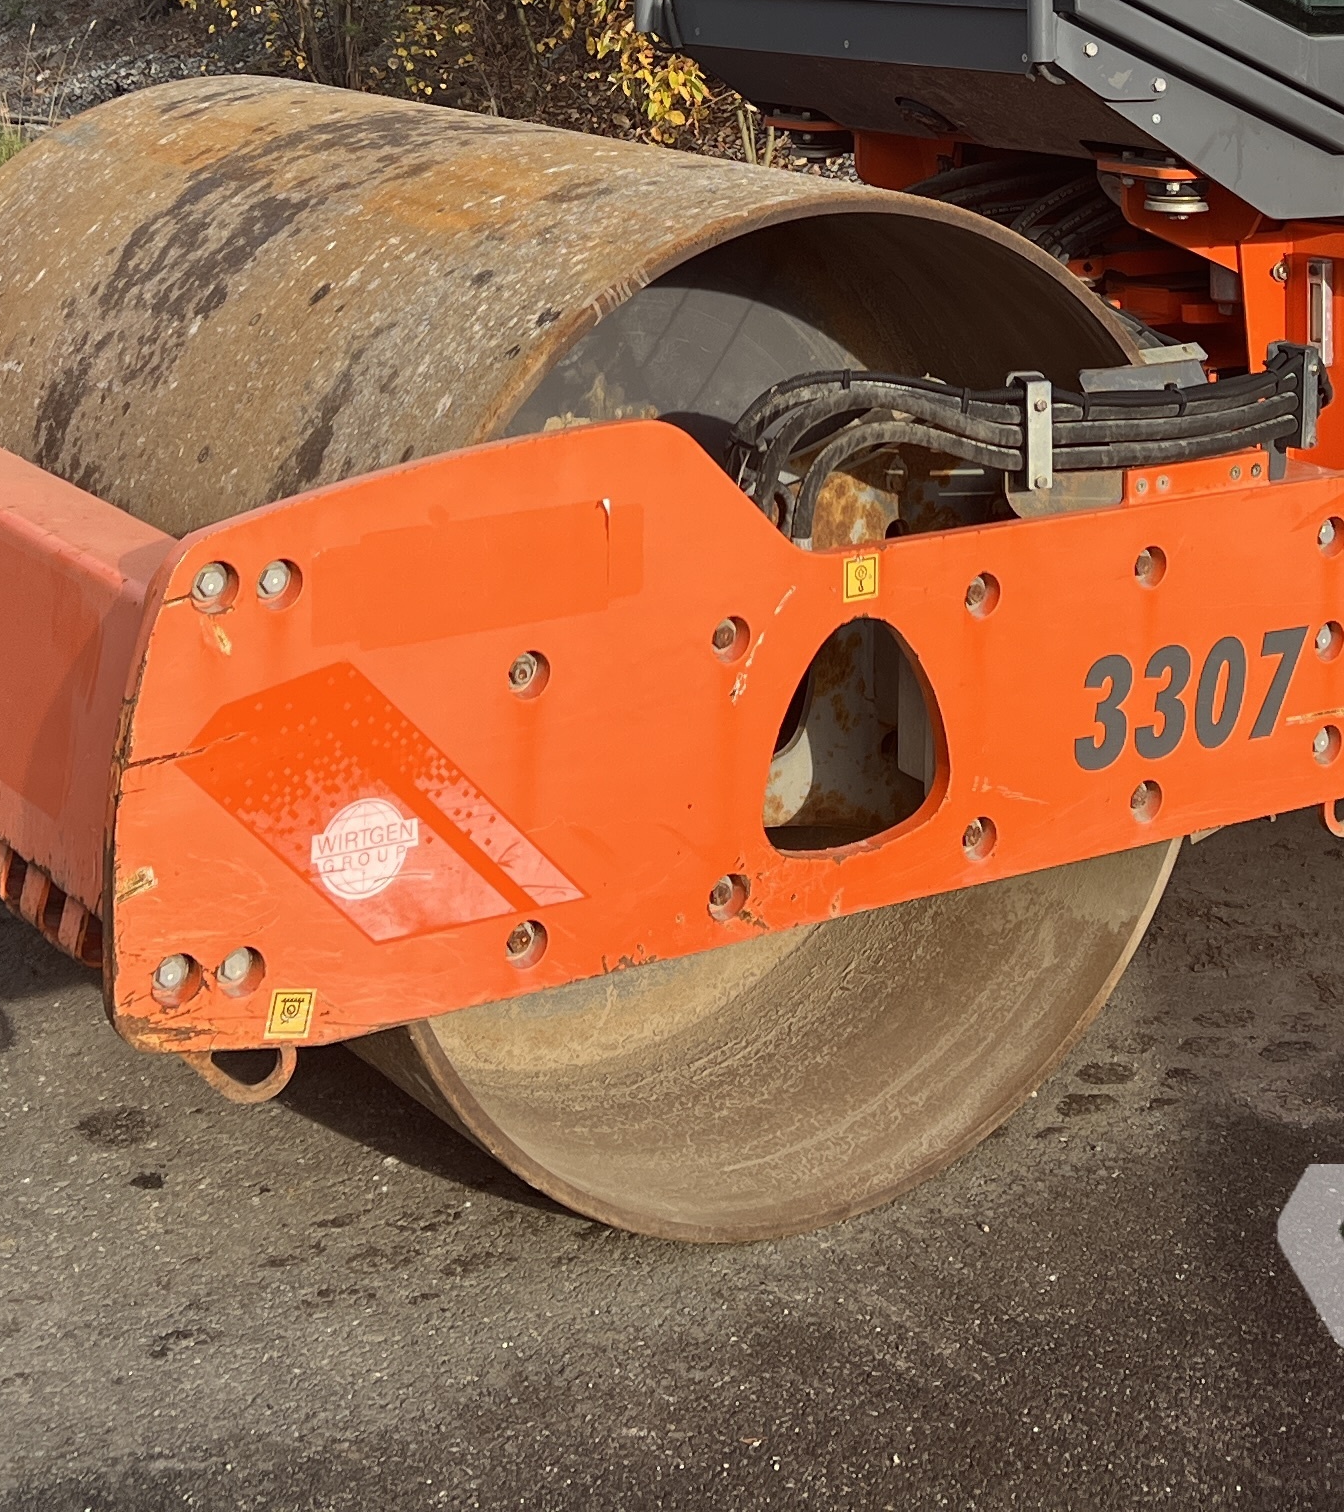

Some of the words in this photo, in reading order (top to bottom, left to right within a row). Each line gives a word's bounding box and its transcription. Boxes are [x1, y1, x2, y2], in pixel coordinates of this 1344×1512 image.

[1073, 624, 1310, 772] 3307
[316, 819, 414, 856] WIRTGEN
[322, 844, 406, 873] GROUP
